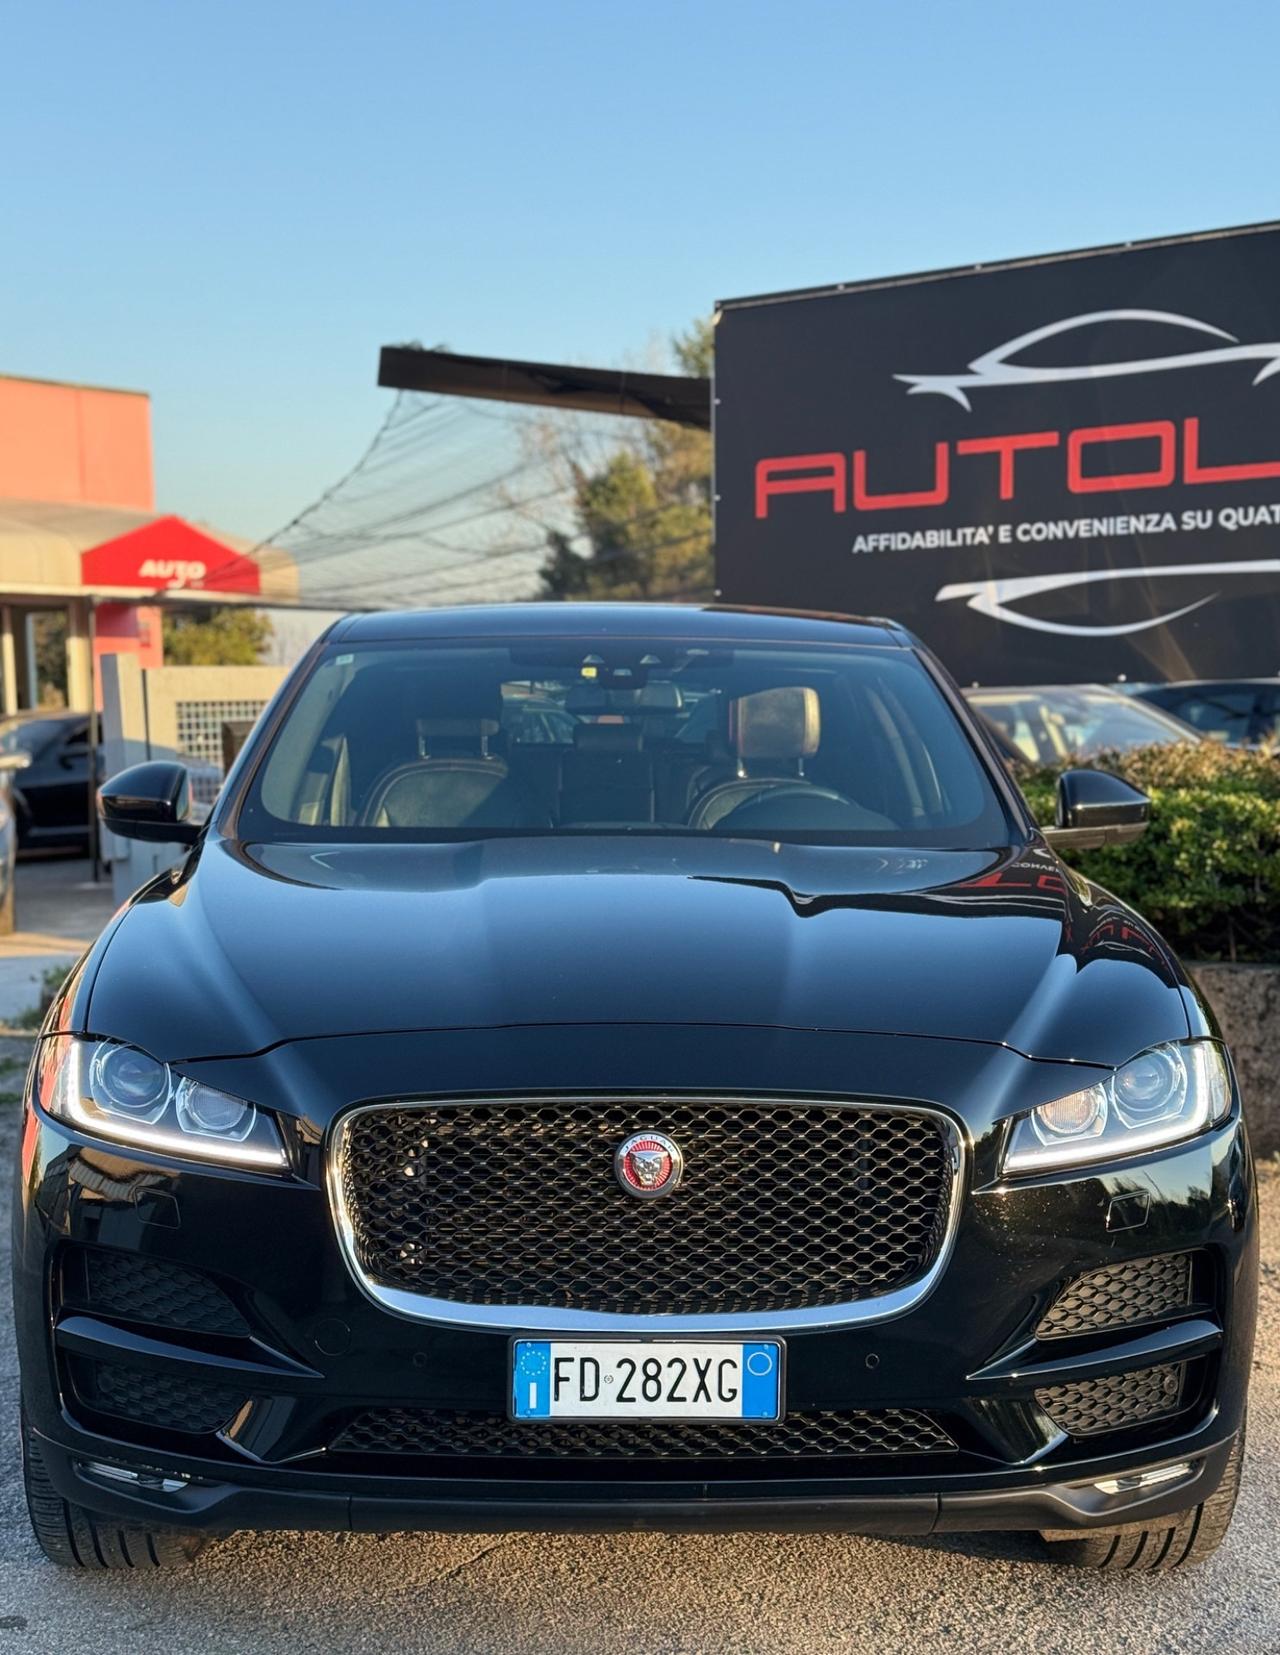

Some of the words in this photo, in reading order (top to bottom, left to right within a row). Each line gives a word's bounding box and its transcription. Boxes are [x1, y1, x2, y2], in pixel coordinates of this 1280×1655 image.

[852, 525, 995, 554] AFFIDABILITA'
[998, 523, 1012, 543] E
[1016, 513, 1177, 543] CONVENIENZA
[1181, 509, 1213, 532] SU
[553, 1356, 601, 1402] FD
[615, 1357, 738, 1403] 282XG
